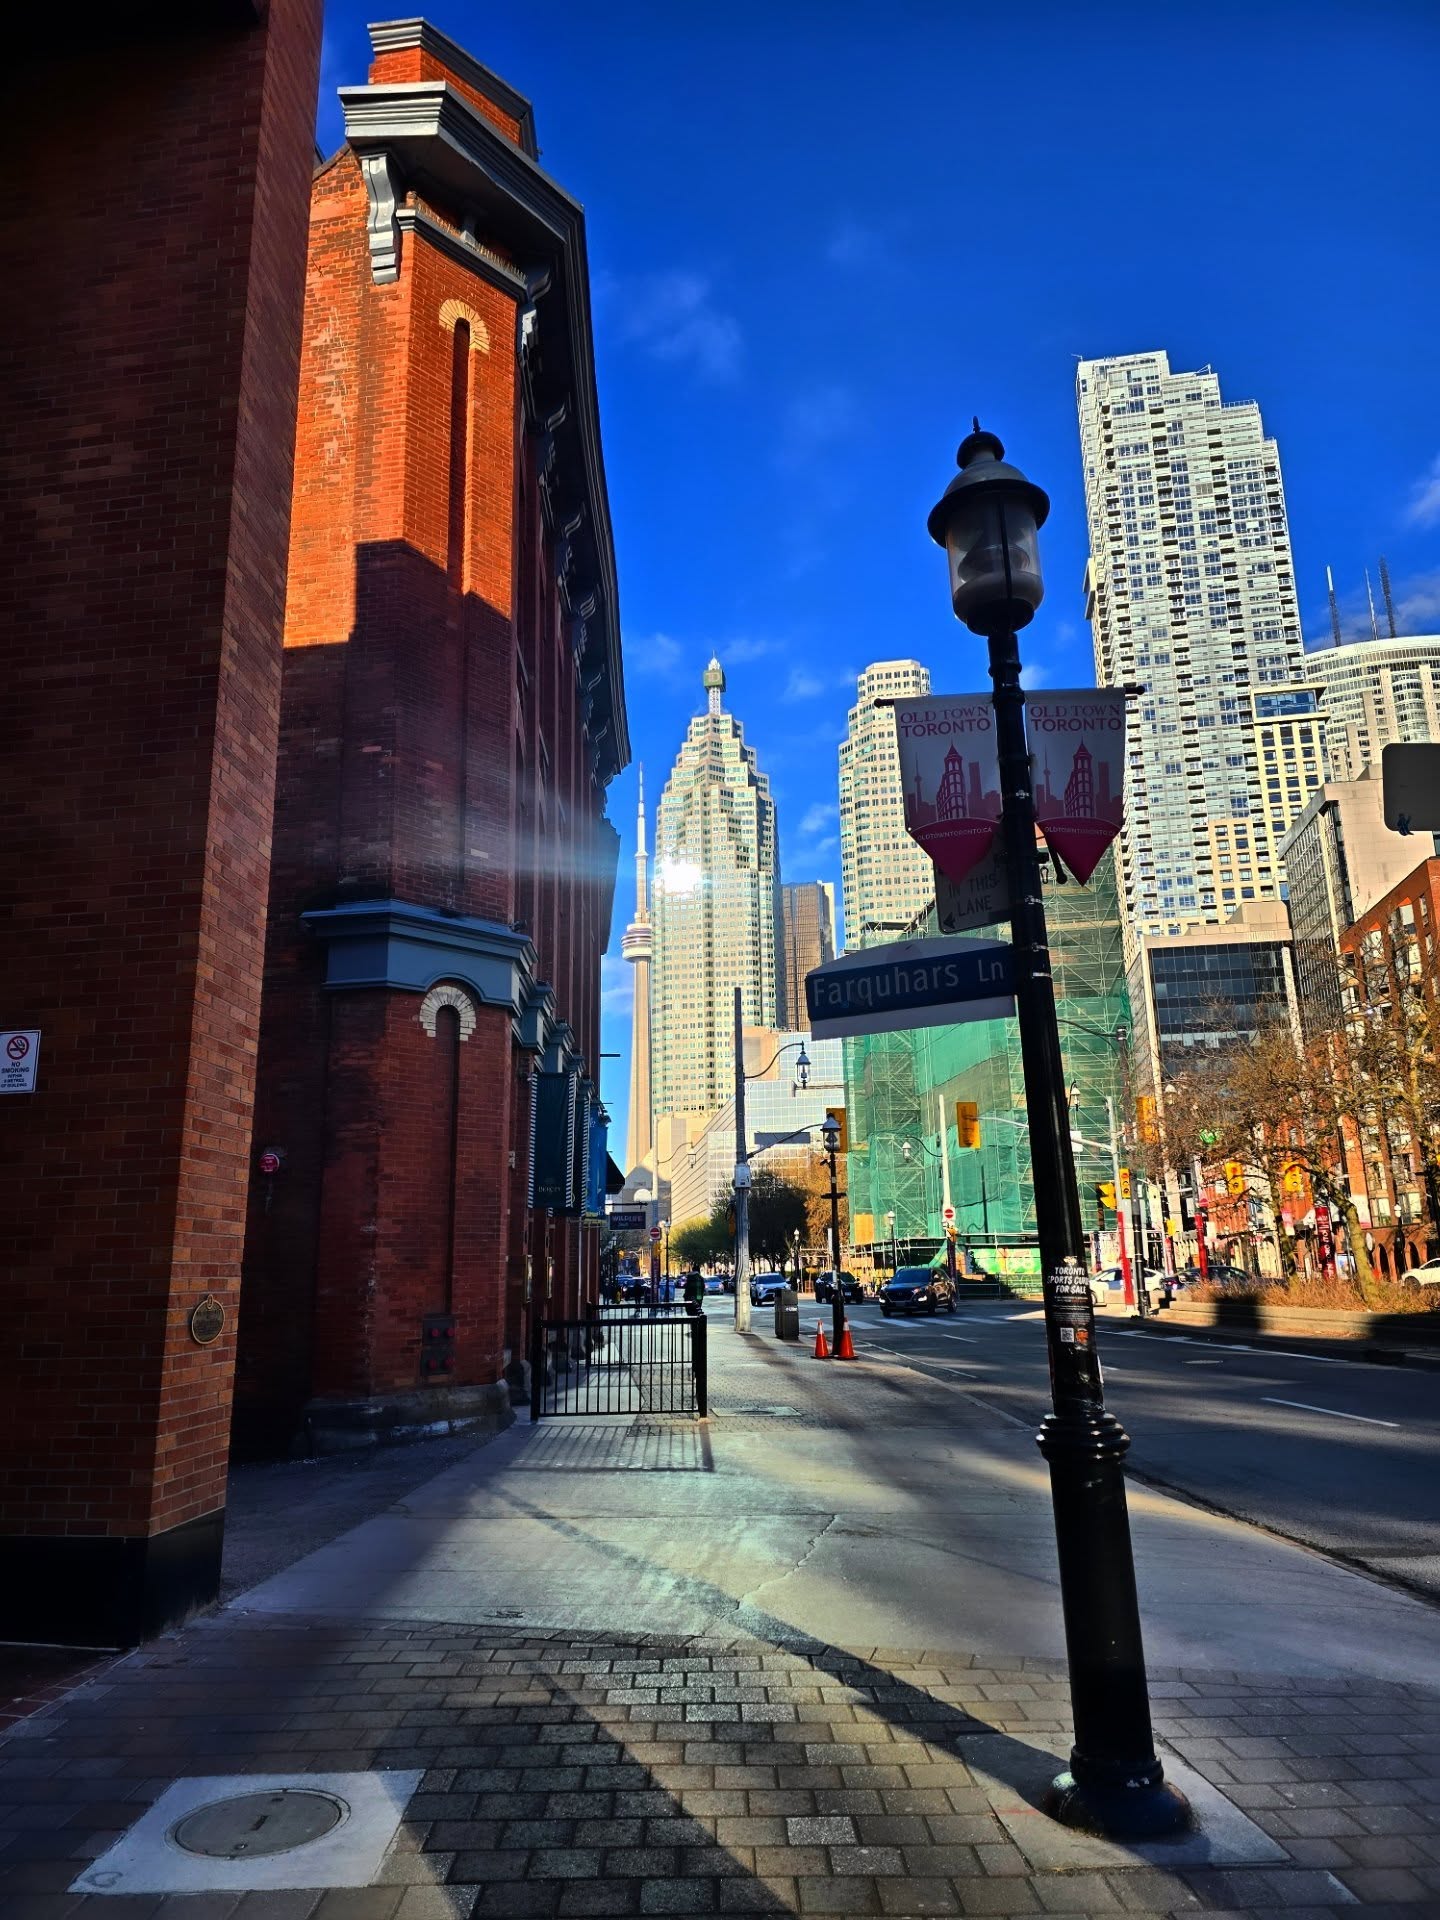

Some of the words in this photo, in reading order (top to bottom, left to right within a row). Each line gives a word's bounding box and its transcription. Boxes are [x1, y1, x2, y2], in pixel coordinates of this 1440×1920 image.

[900, 709, 937, 724] OLD
[943, 704, 989, 720] TOWN
[1030, 704, 1067, 718] OLD
[1070, 703, 1121, 717] TOWN
[900, 717, 991, 738] TORONTO
[1031, 717, 1123, 732] TORONTO
[967, 873, 999, 892] THIS
[957, 895, 993, 916] LANE
[812, 963, 960, 1008] Farquhars
[976, 958, 1006, 983] Ln
[1055, 1285, 1070, 1294] FOR
[1070, 1285, 1087, 1295] SALE
